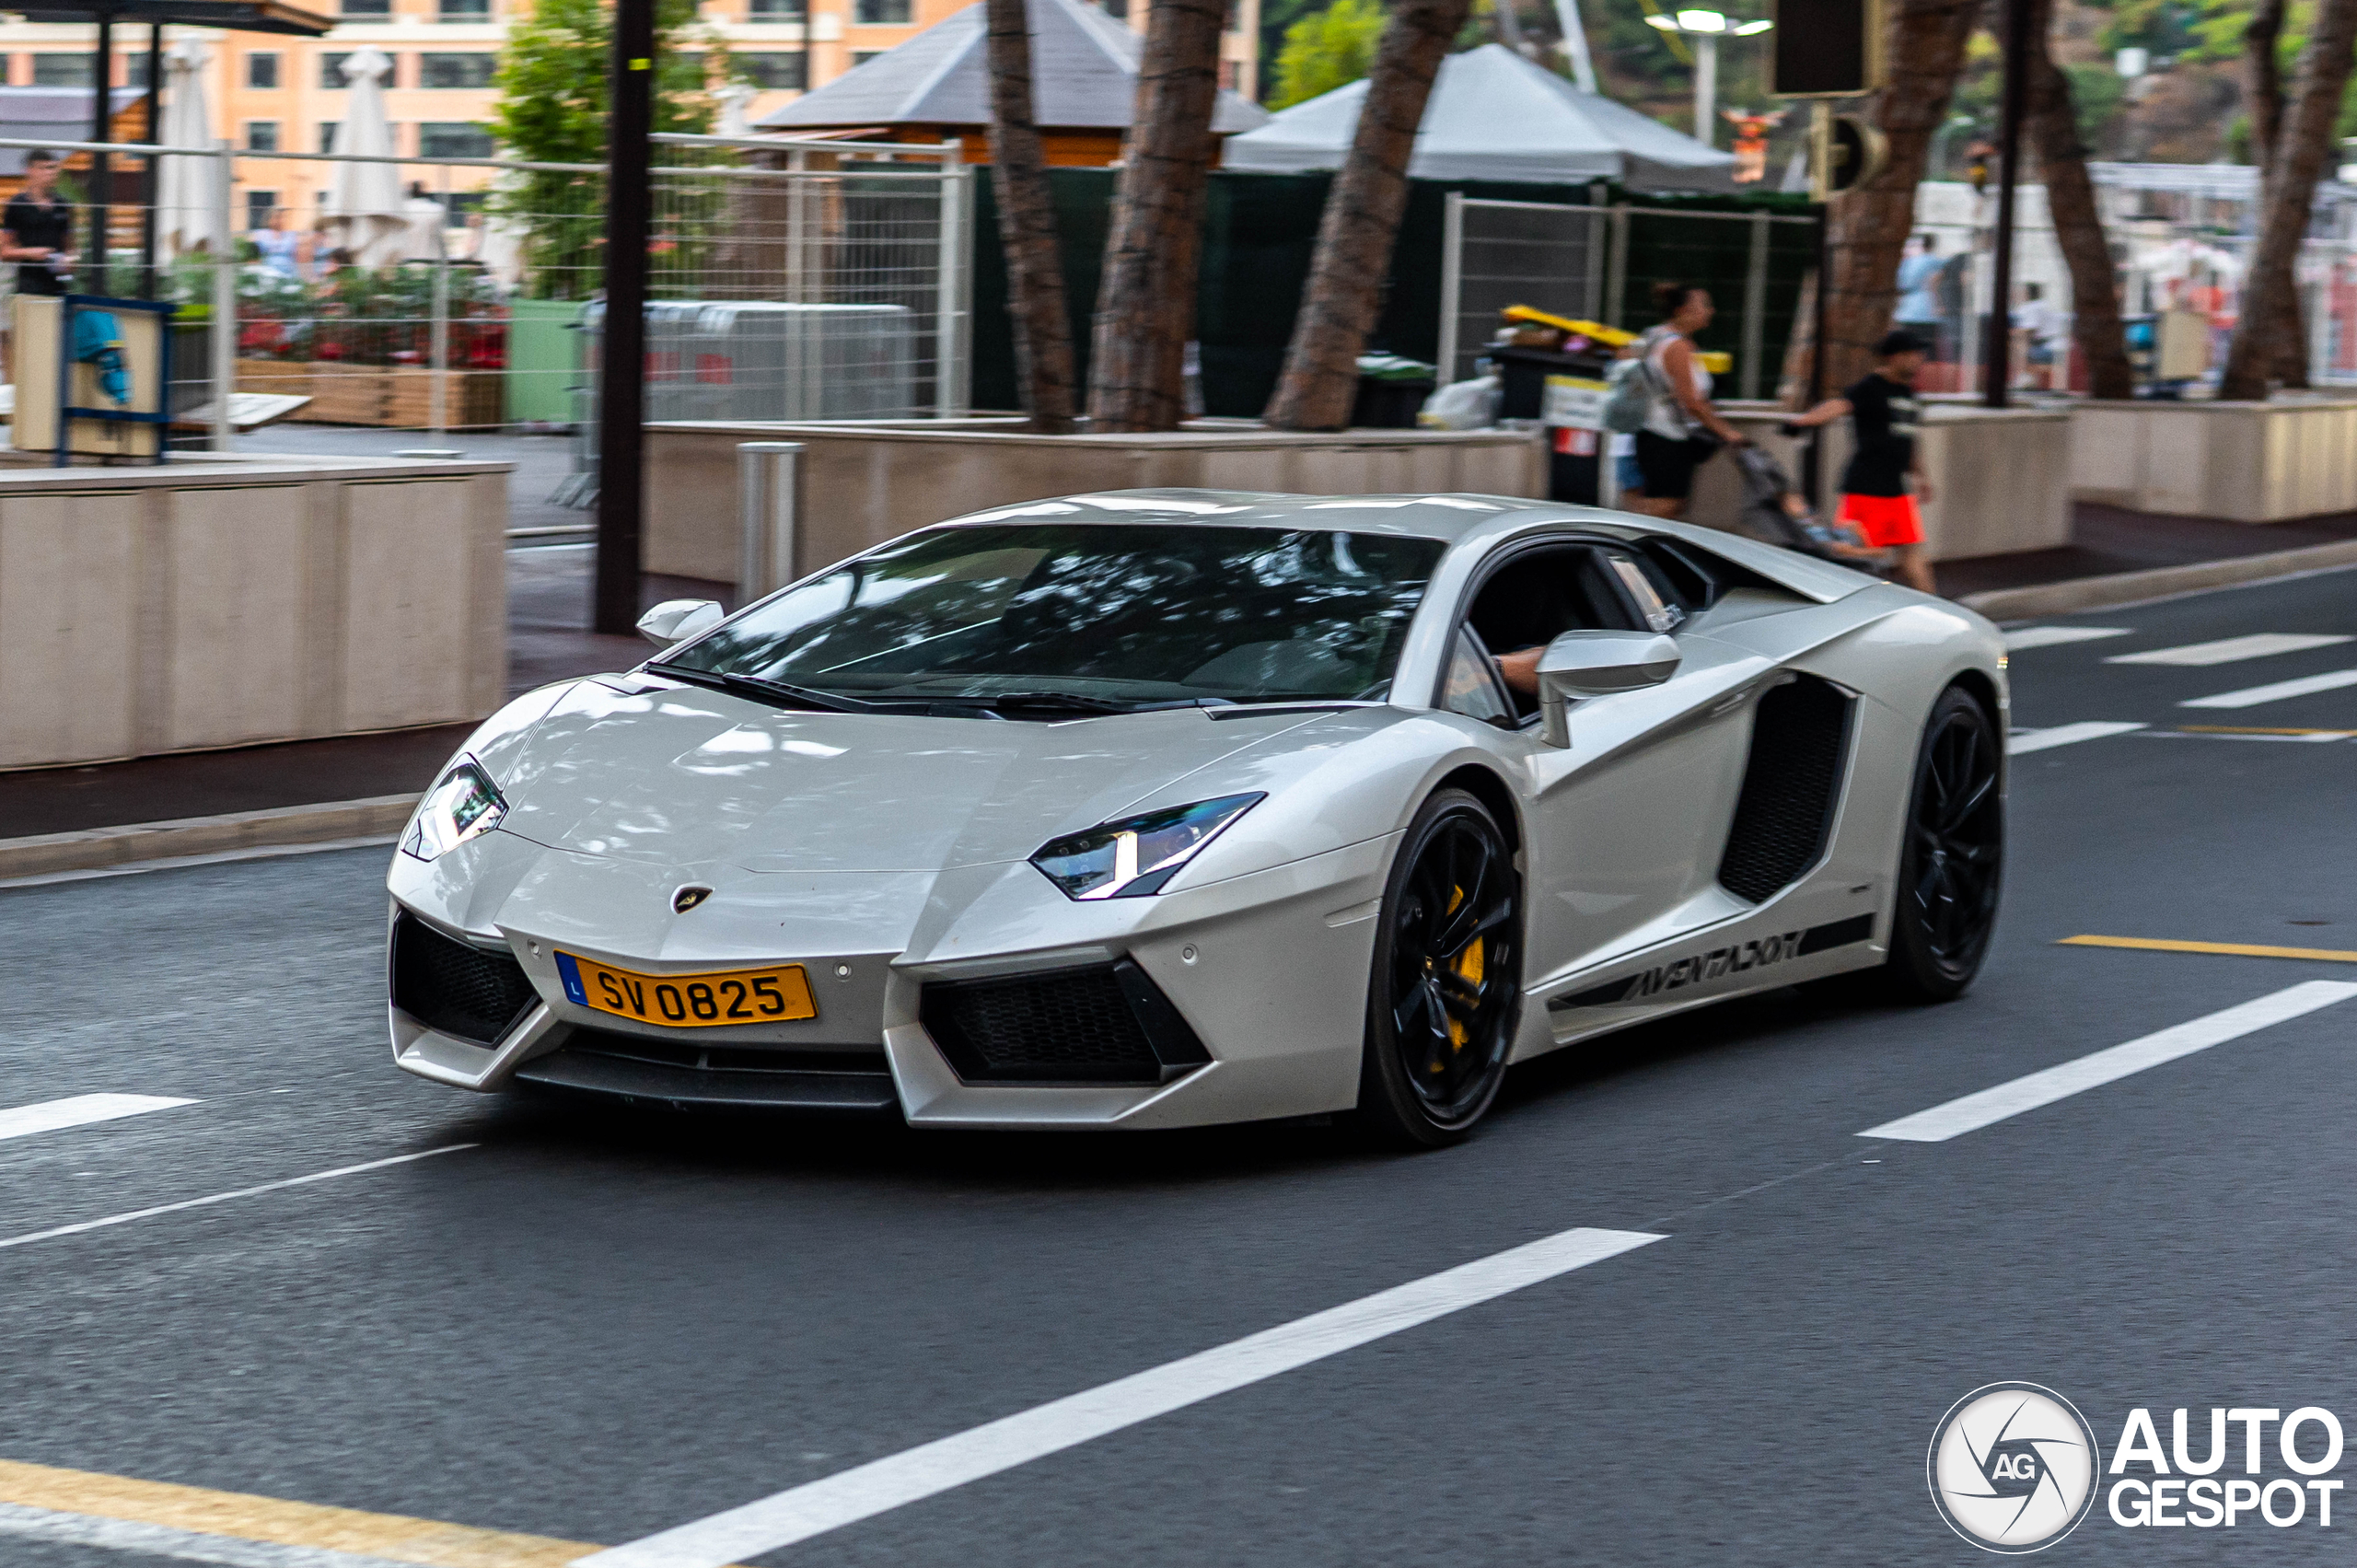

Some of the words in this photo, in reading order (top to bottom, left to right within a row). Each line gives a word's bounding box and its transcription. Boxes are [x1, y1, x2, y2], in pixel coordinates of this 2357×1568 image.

[598, 970, 646, 1016] SV
[655, 975, 786, 1021] 0825
[1621, 929, 1807, 1002] AVENTADOR
